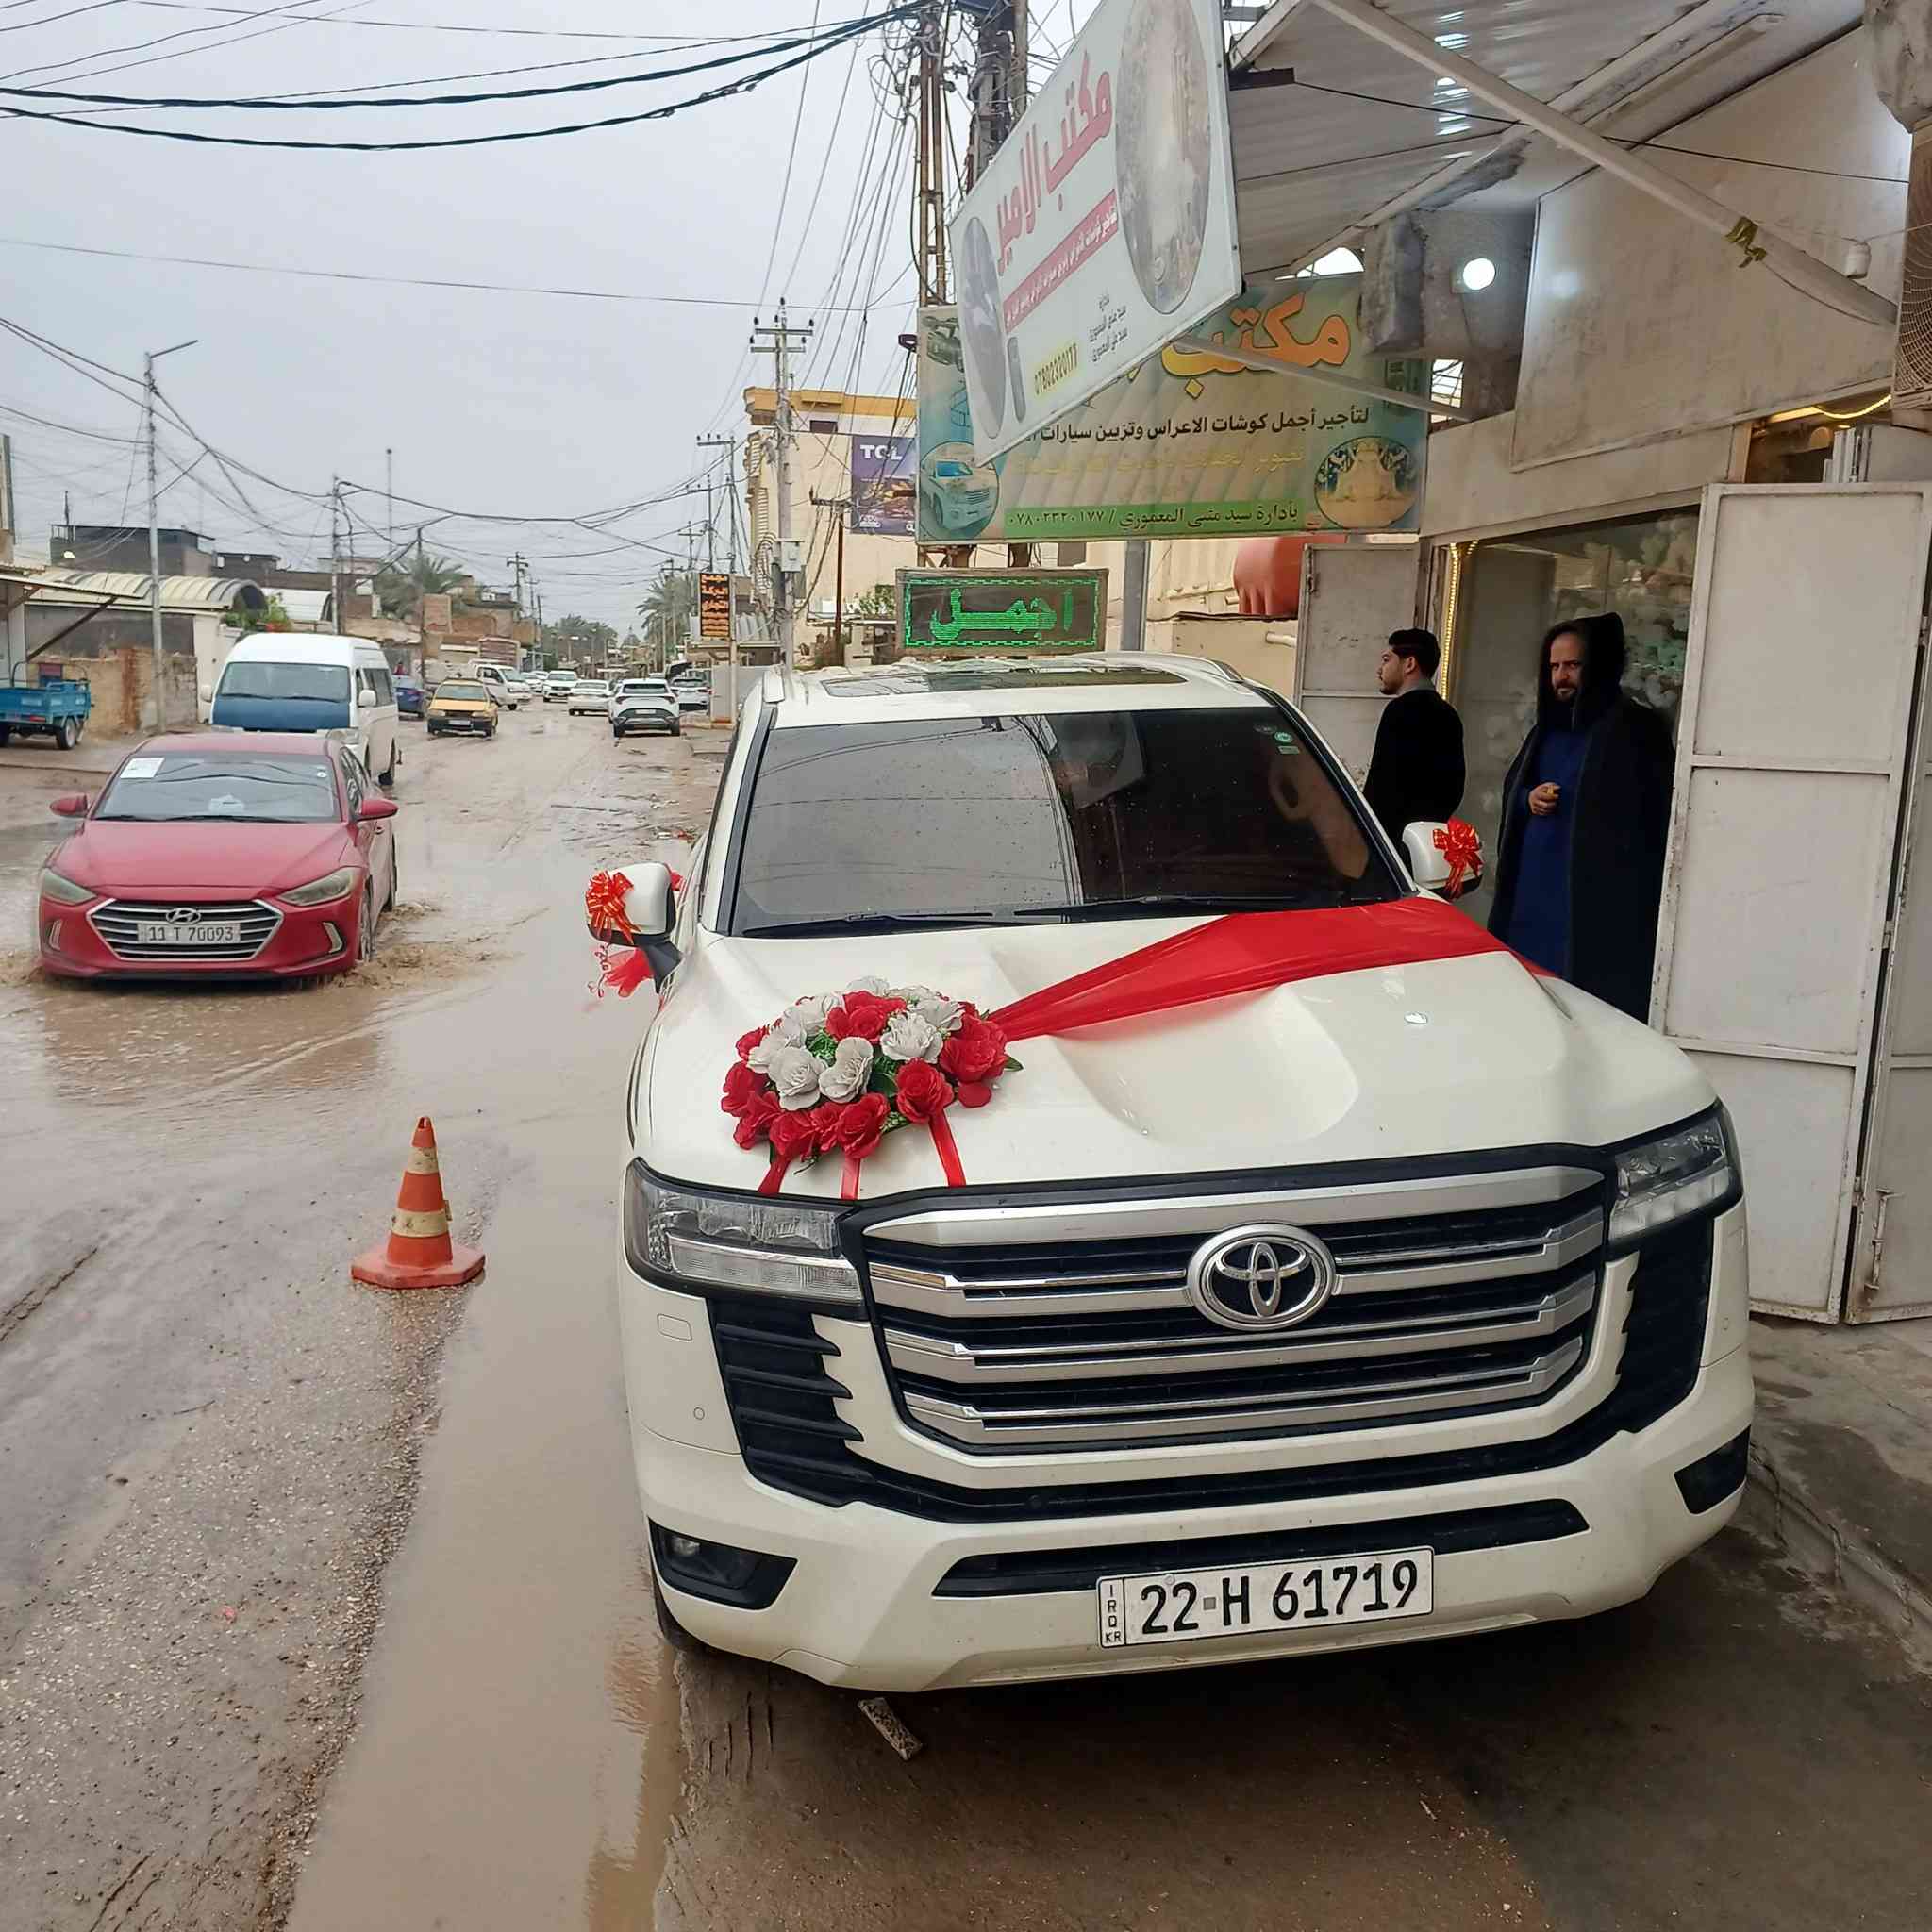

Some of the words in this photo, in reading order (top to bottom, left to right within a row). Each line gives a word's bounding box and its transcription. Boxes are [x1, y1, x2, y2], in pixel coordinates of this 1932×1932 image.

[1043, 50, 1113, 211] مكتب
[997, 123, 1042, 276] الامير
[1161, 292, 1351, 400] مكتب
[1147, 416, 1208, 440] الاعراس
[1211, 412, 1269, 434] كوشات
[1272, 407, 1316, 432] أجمل
[1317, 404, 1370, 431] لتأجير
[1041, 423, 1092, 443] سيارات
[1095, 421, 1144, 442] وتزيين
[859, 444, 903, 460] TCL
[1224, 508, 1253, 525] سيد
[149, 926, 166, 941] 11
[173, 926, 182, 941] T
[189, 926, 234, 941] 70093
[1141, 1582, 1199, 1635] 22
[1221, 1575, 1251, 1626] H
[1272, 1558, 1419, 1621] 61719
[1105, 1631, 1123, 1644] KR
